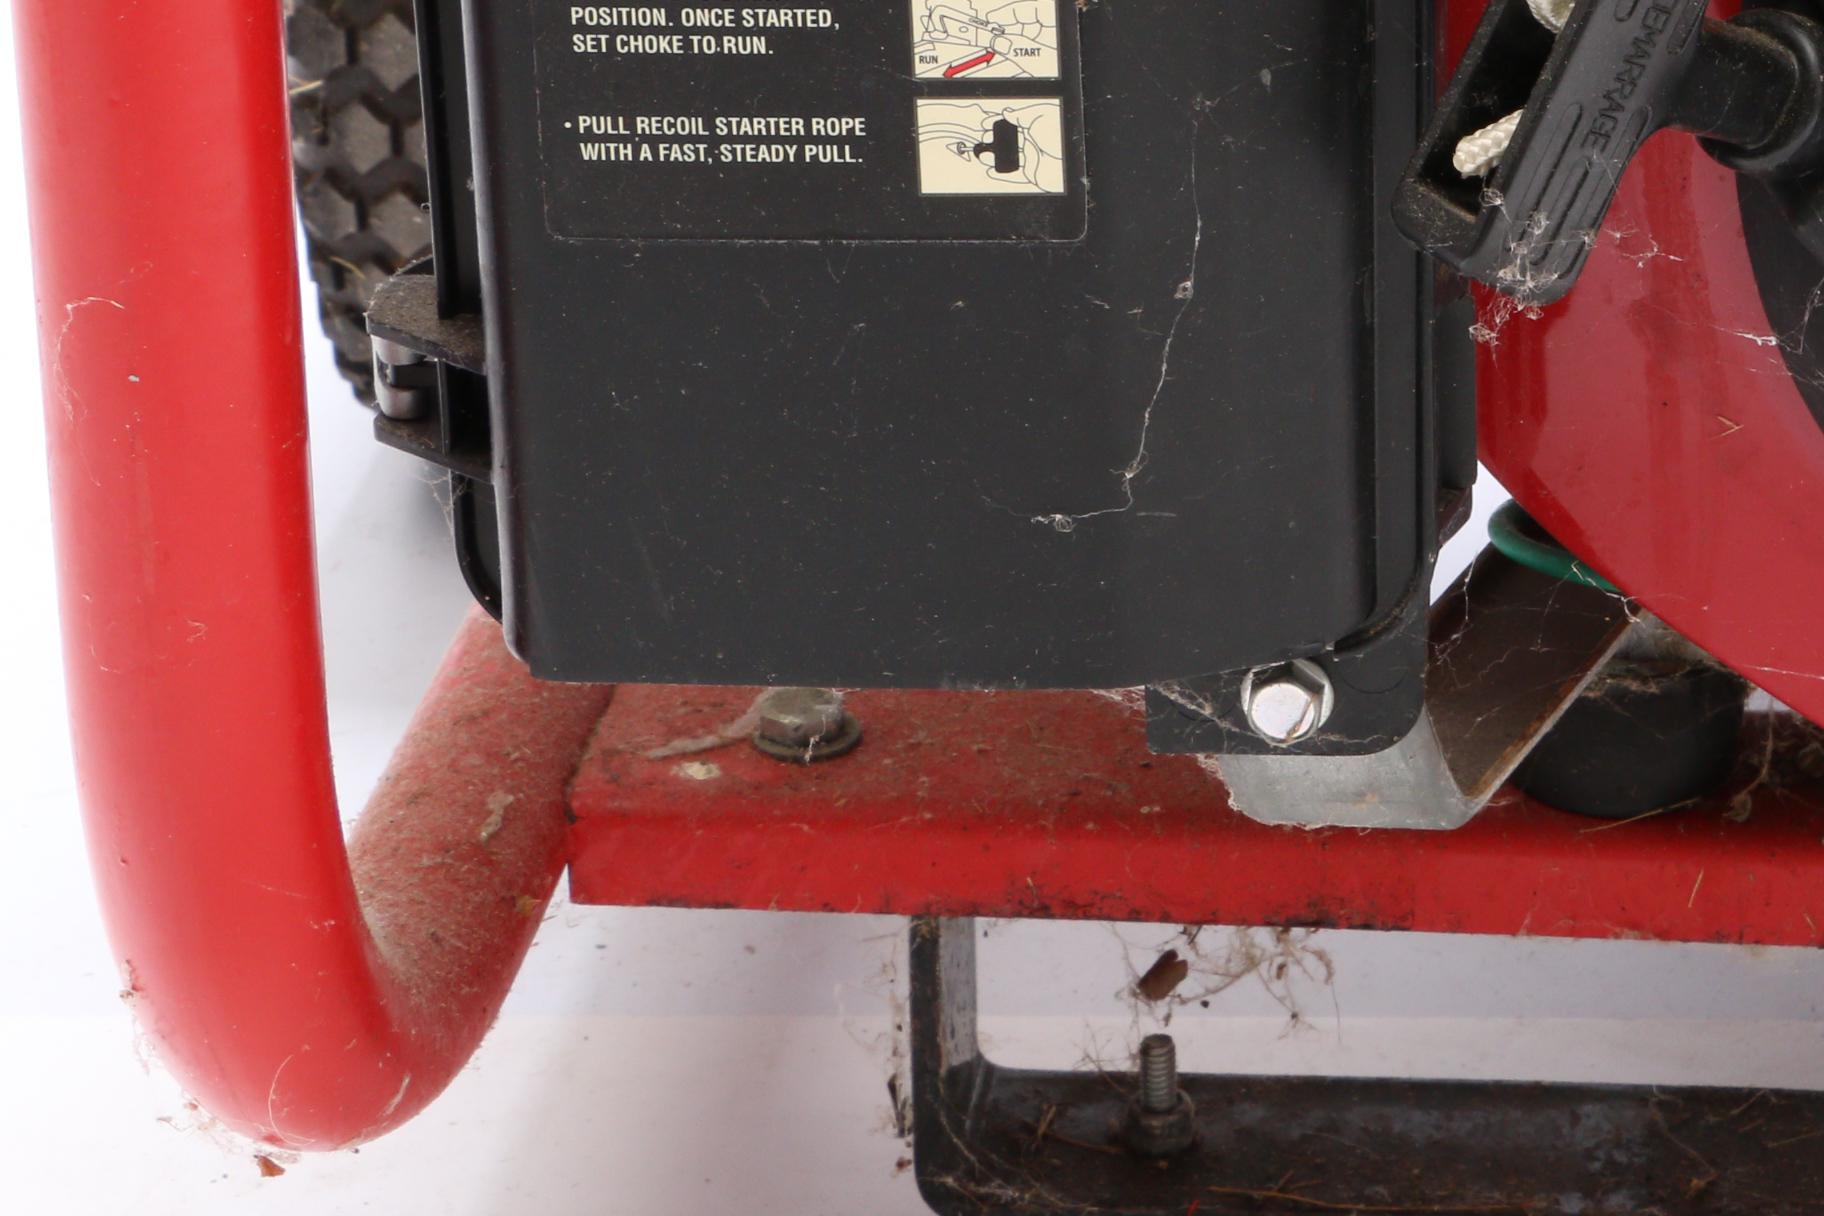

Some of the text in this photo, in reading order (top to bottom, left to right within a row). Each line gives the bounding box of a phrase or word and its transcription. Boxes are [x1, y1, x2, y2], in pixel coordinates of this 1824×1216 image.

[570, 7, 840, 30] POSITION. ONCE STARTED,
[572, 34, 774, 55] SET CHOKE TO RUN.
[1012, 48, 1042, 58] START
[918, 56, 939, 65] RUN
[578, 116, 866, 136] PULL RECOIL STARTER ROPE
[579, 143, 863, 165] WITH A FAST, STEADY PULL.
